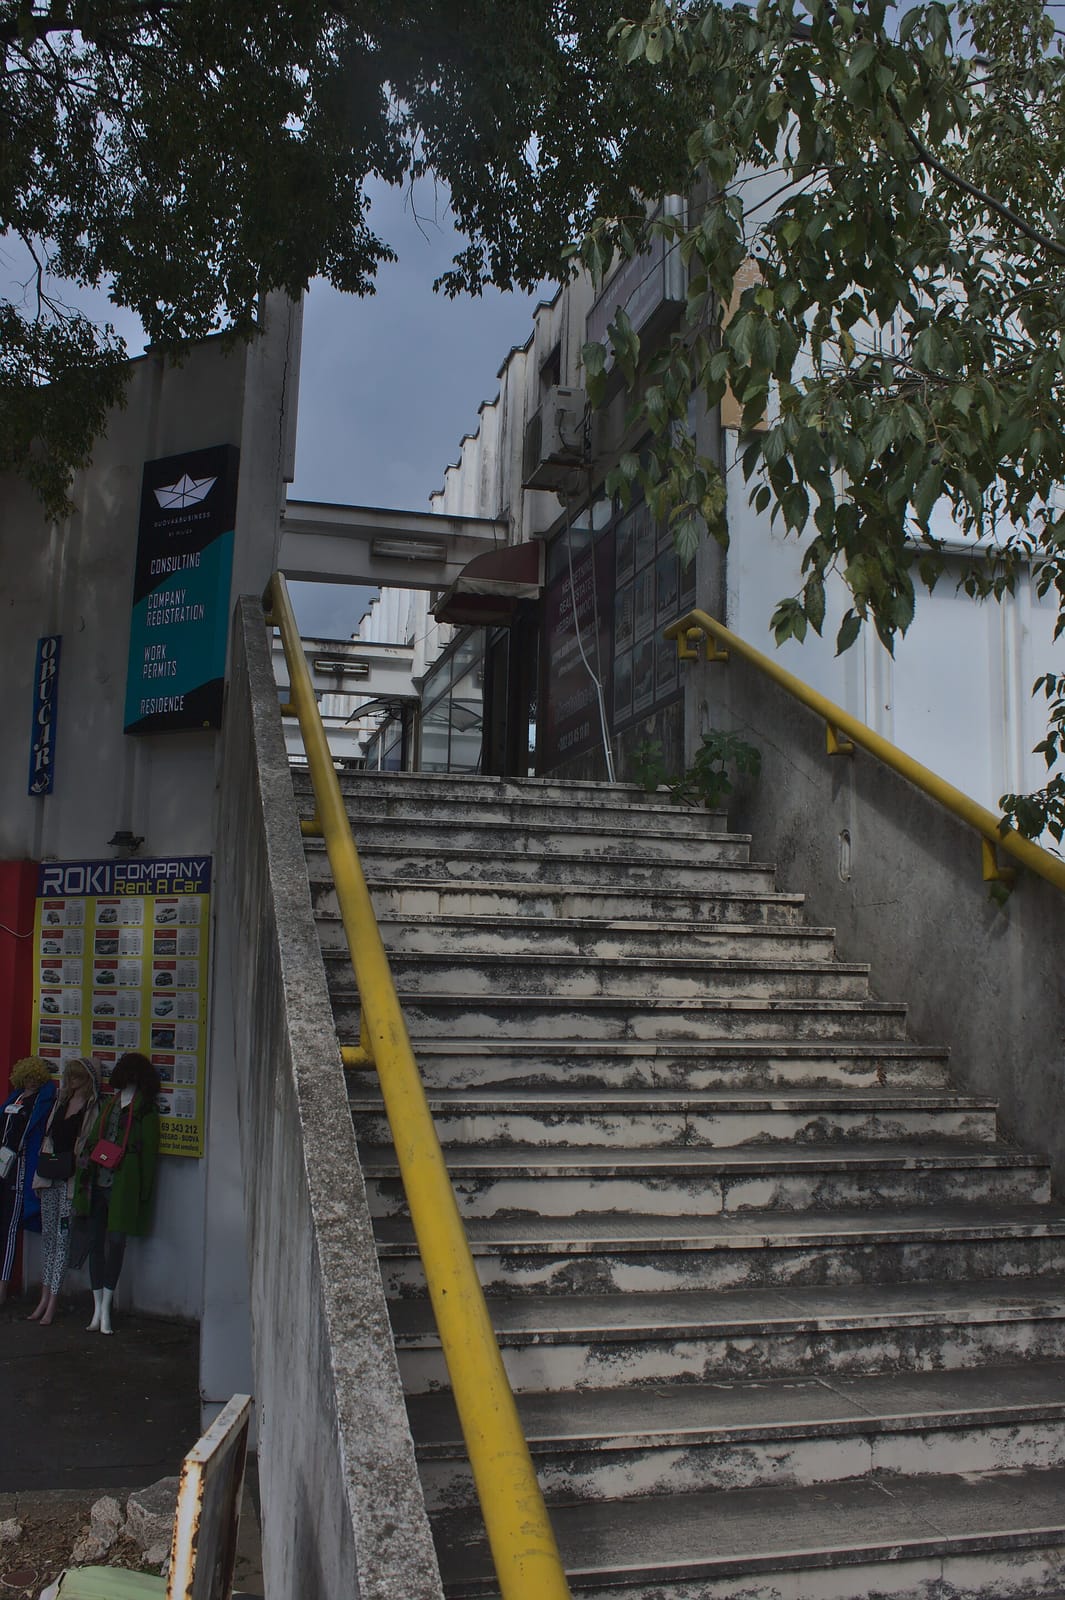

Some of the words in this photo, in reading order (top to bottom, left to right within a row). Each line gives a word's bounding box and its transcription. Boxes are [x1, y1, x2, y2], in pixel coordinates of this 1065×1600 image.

[150, 551, 200, 576] CONSULTING
[147, 589, 186, 610] COMPANY
[146, 604, 204, 626] REGISTRATION
[144, 643, 167, 662] WORK
[143, 660, 177, 679] PERMITS
[140, 695, 185, 714] RESIDENCE
[42, 864, 110, 894] ROKI
[114, 862, 207, 880] COMPANY
[114, 880, 154, 894] Rent
[156, 879, 168, 894] A
[173, 878, 202, 893] Car
[171, 1123, 183, 1132] 343
[185, 1124, 198, 1134] 212
